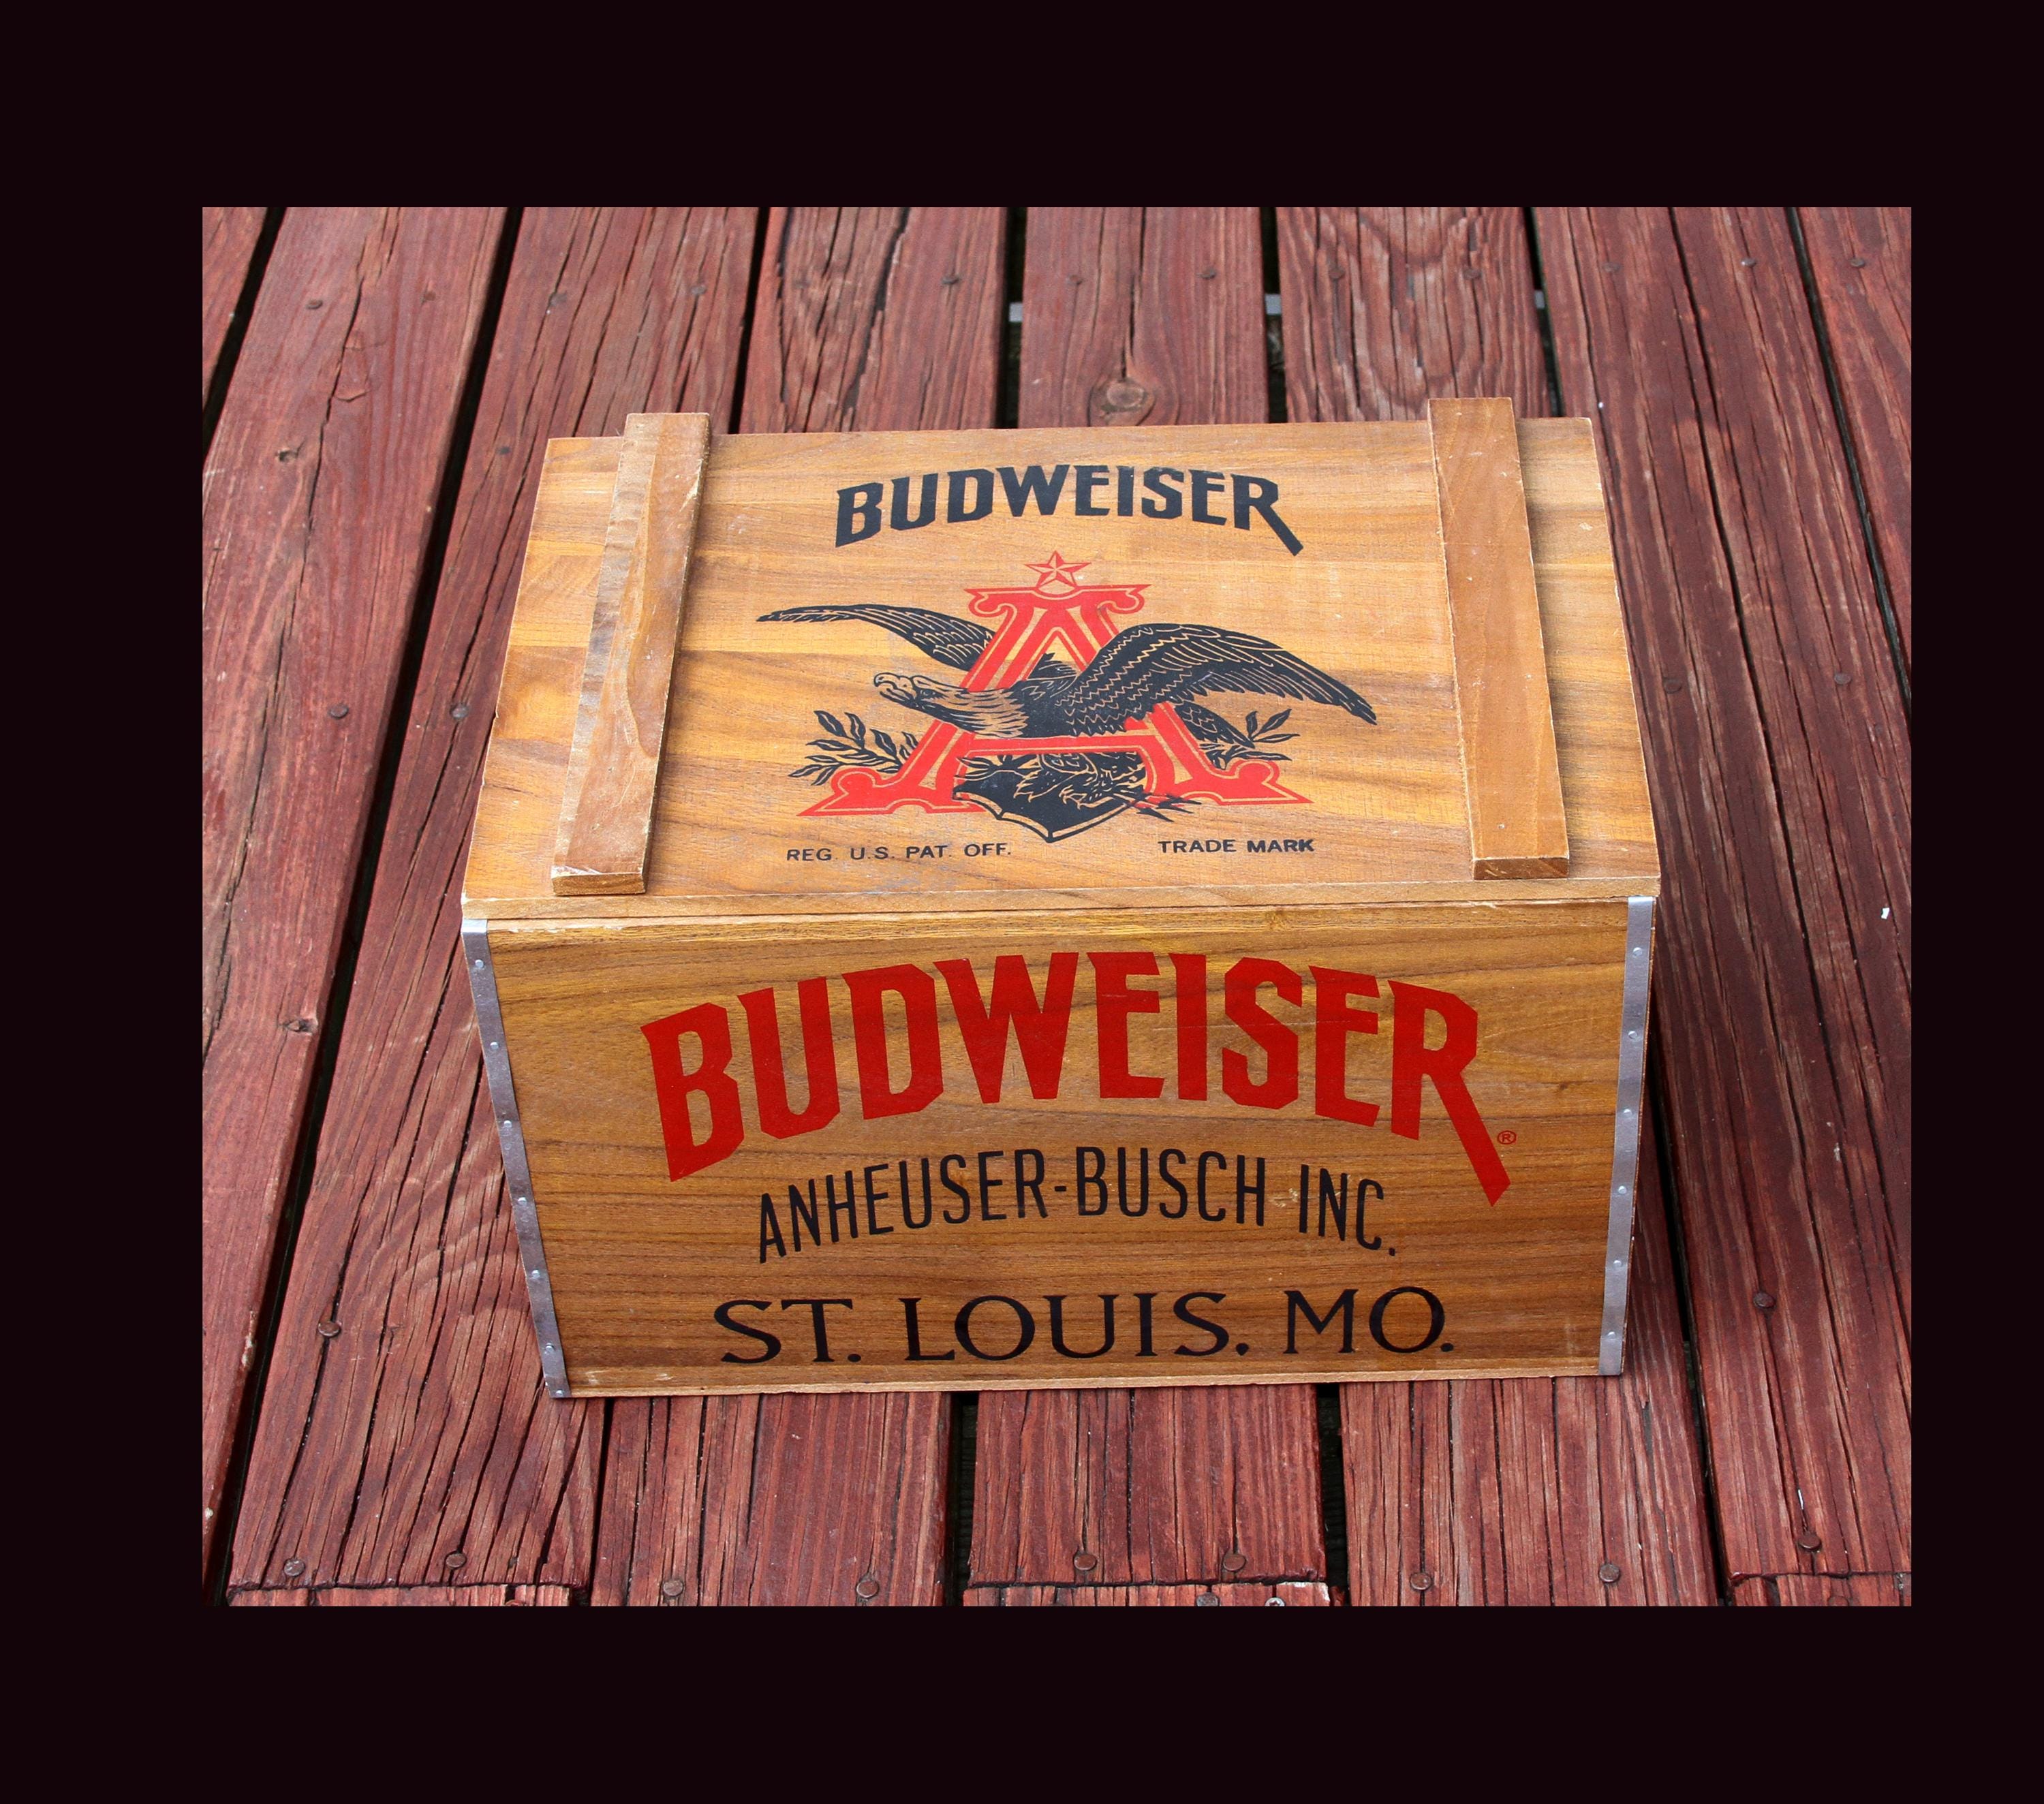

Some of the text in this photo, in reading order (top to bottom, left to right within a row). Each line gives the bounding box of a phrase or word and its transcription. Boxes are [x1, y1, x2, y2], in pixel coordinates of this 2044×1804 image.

[835, 464, 1303, 556] BUDWEISER
[786, 842, 1011, 862] REG. U.S. PAT. OFF.
[1158, 839, 1315, 854] TRADE MARK
[640, 951, 1511, 1207] BUDWEISER
[758, 1146, 1396, 1264] ANHEUSER-BUSCH INC.
[713, 1286, 1455, 1364] ST. LOUIS. MO.
